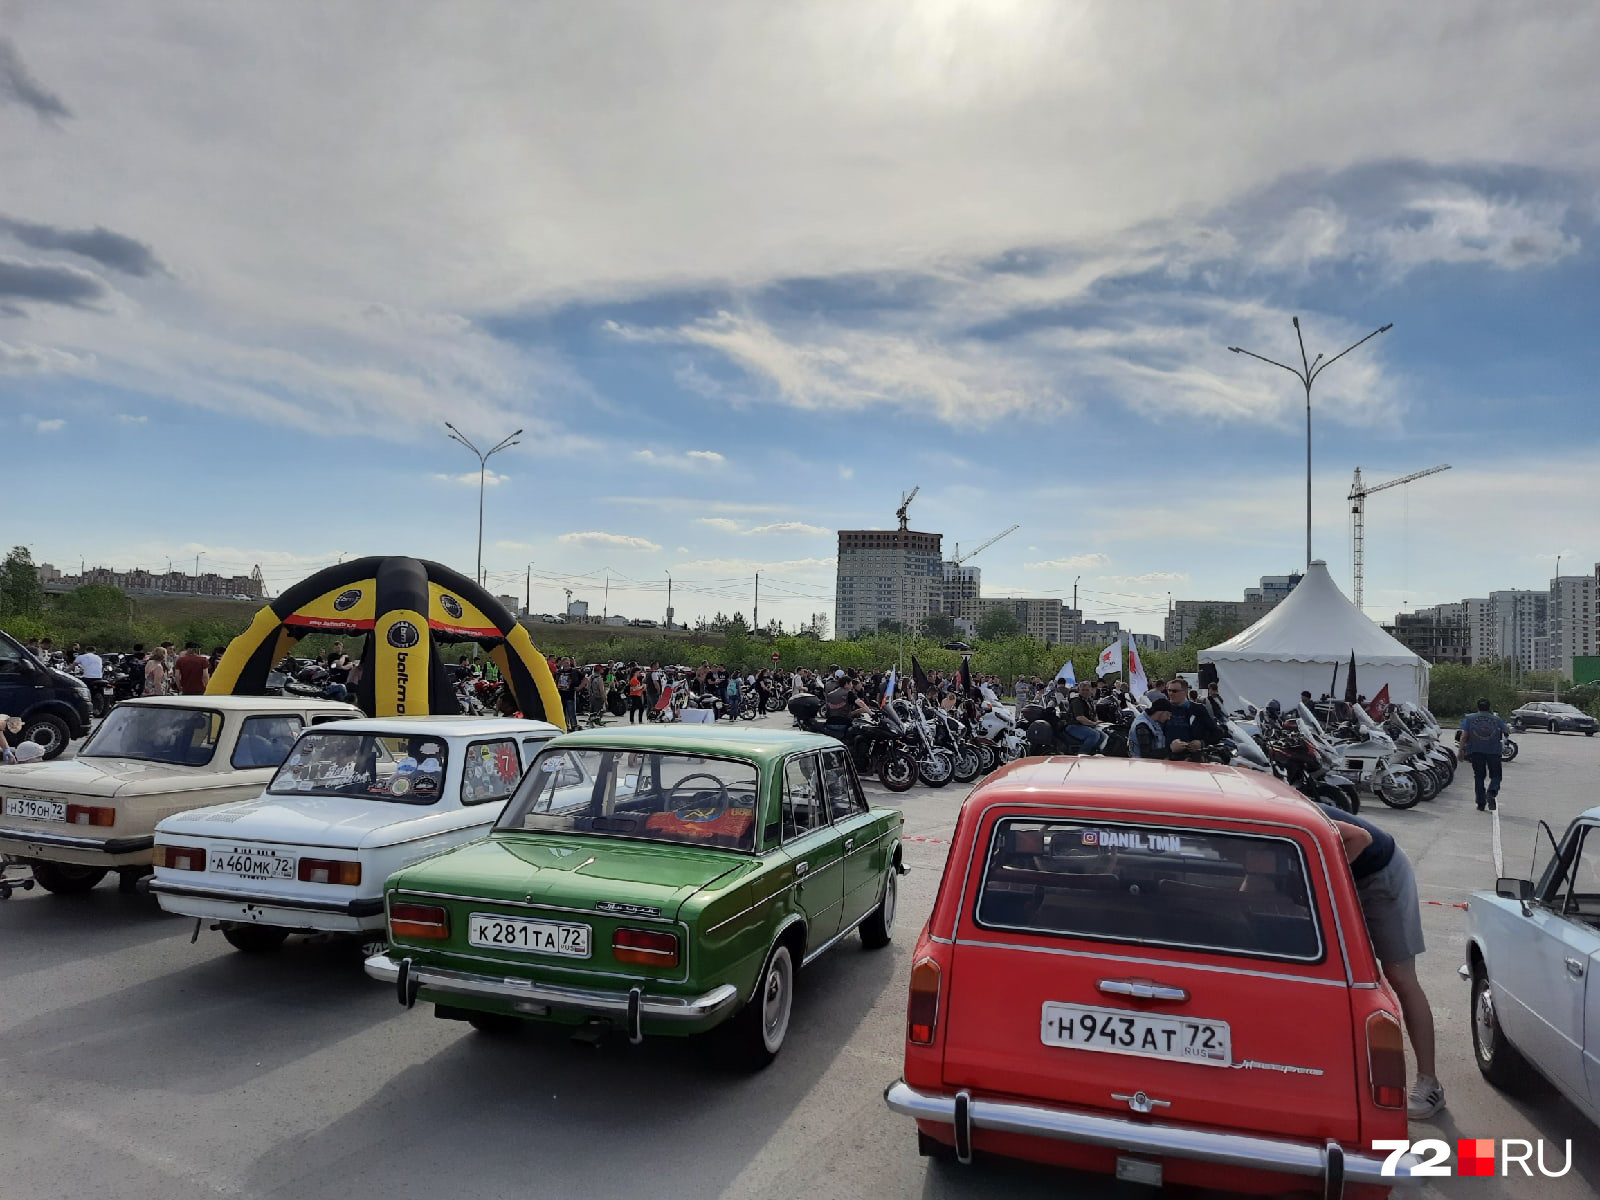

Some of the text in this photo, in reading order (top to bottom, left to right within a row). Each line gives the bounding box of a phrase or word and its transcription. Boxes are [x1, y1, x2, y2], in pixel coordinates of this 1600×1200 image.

[397, 652, 408, 716] baltmo
[10, 801, 63, 816] Н319ОН 72
[216, 855, 289, 875] А460МК 72
[479, 922, 581, 949] К281ТА 72
[1058, 1014, 1217, 1052] Н943АТ 72
[1184, 1046, 1207, 1058] RUS
